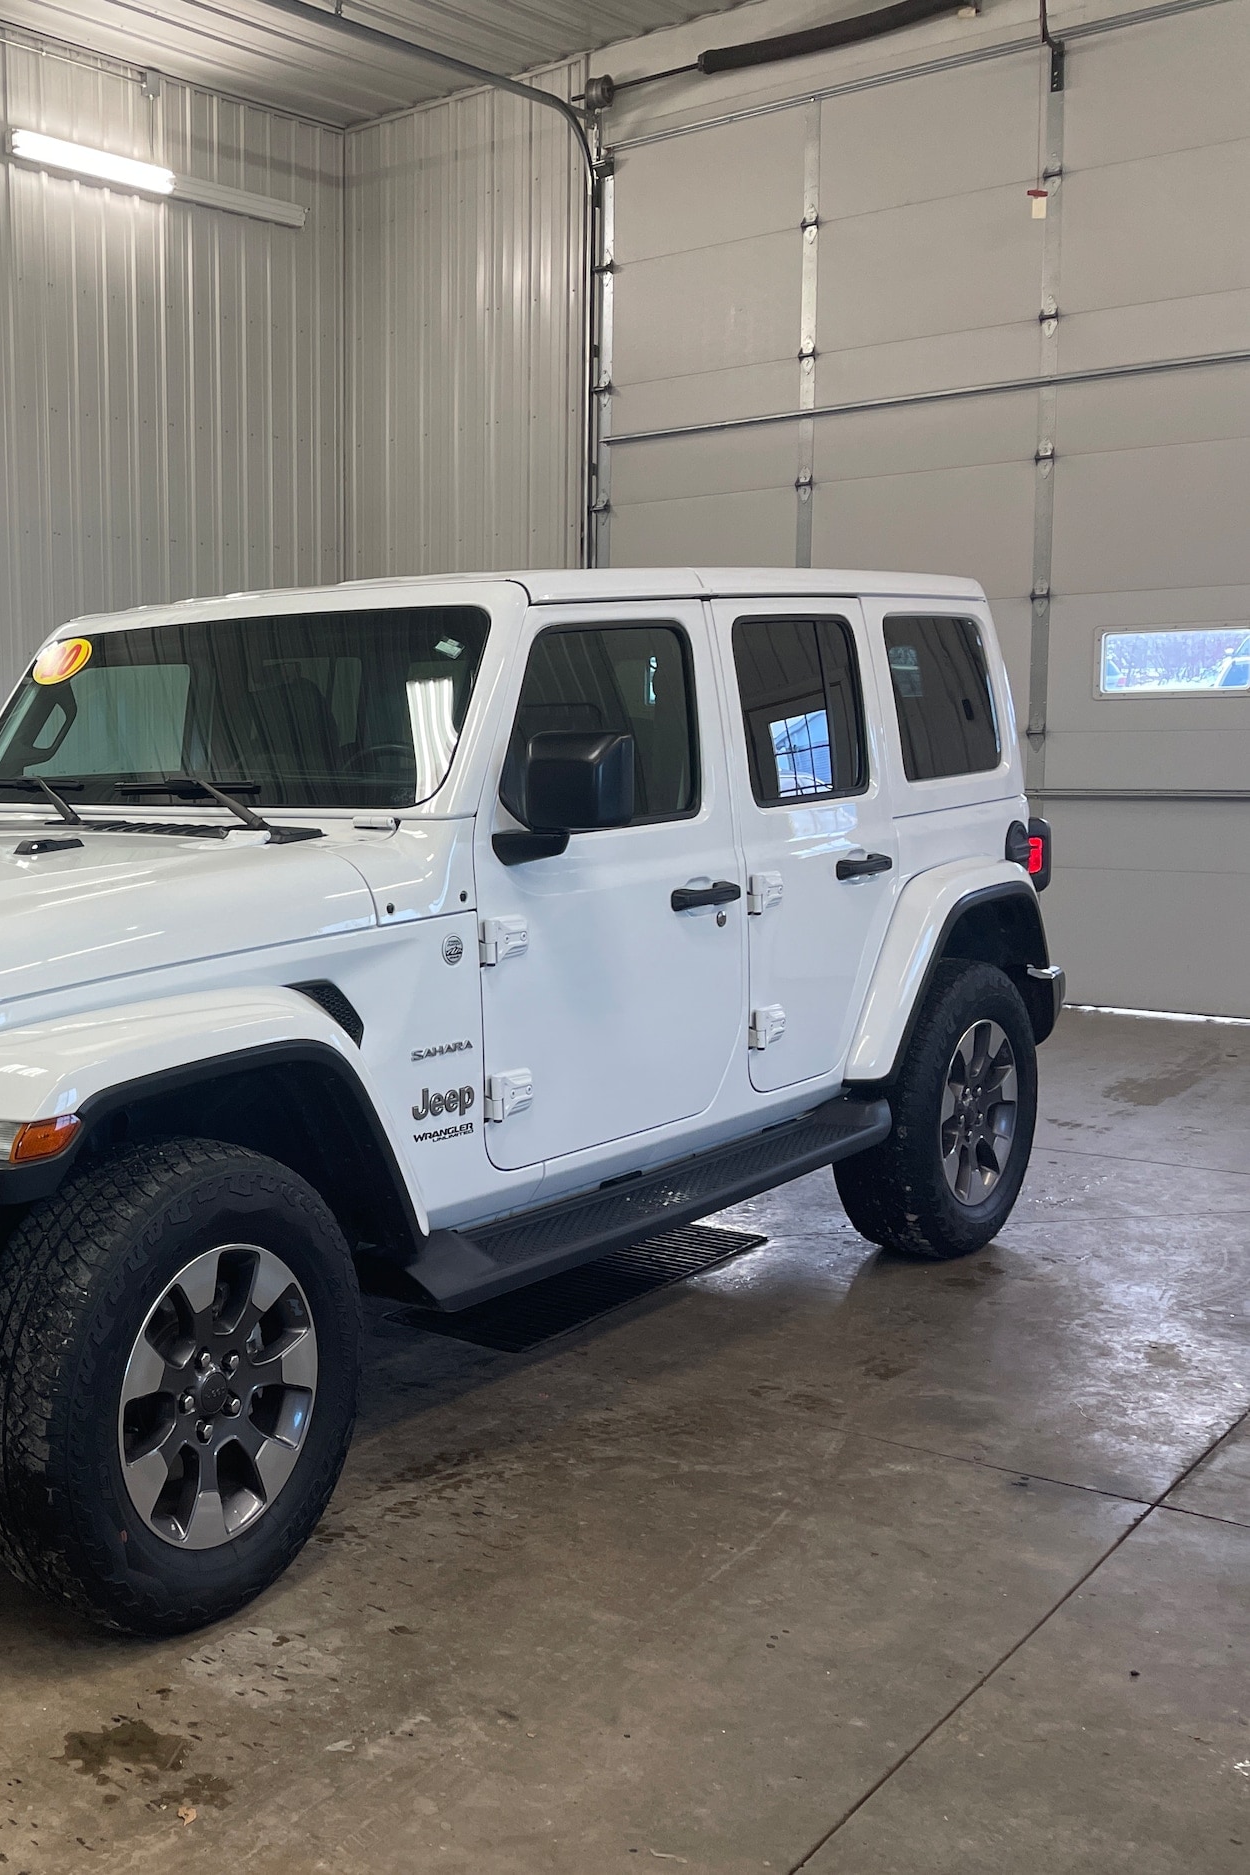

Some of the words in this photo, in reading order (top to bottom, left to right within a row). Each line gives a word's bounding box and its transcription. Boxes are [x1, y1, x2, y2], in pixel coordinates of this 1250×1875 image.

[411, 1040, 473, 1062] SAHARA
[412, 1085, 475, 1121] Jeep
[413, 1122, 474, 1143] WRANGLER
[432, 1129, 474, 1143] UNLIMITED
